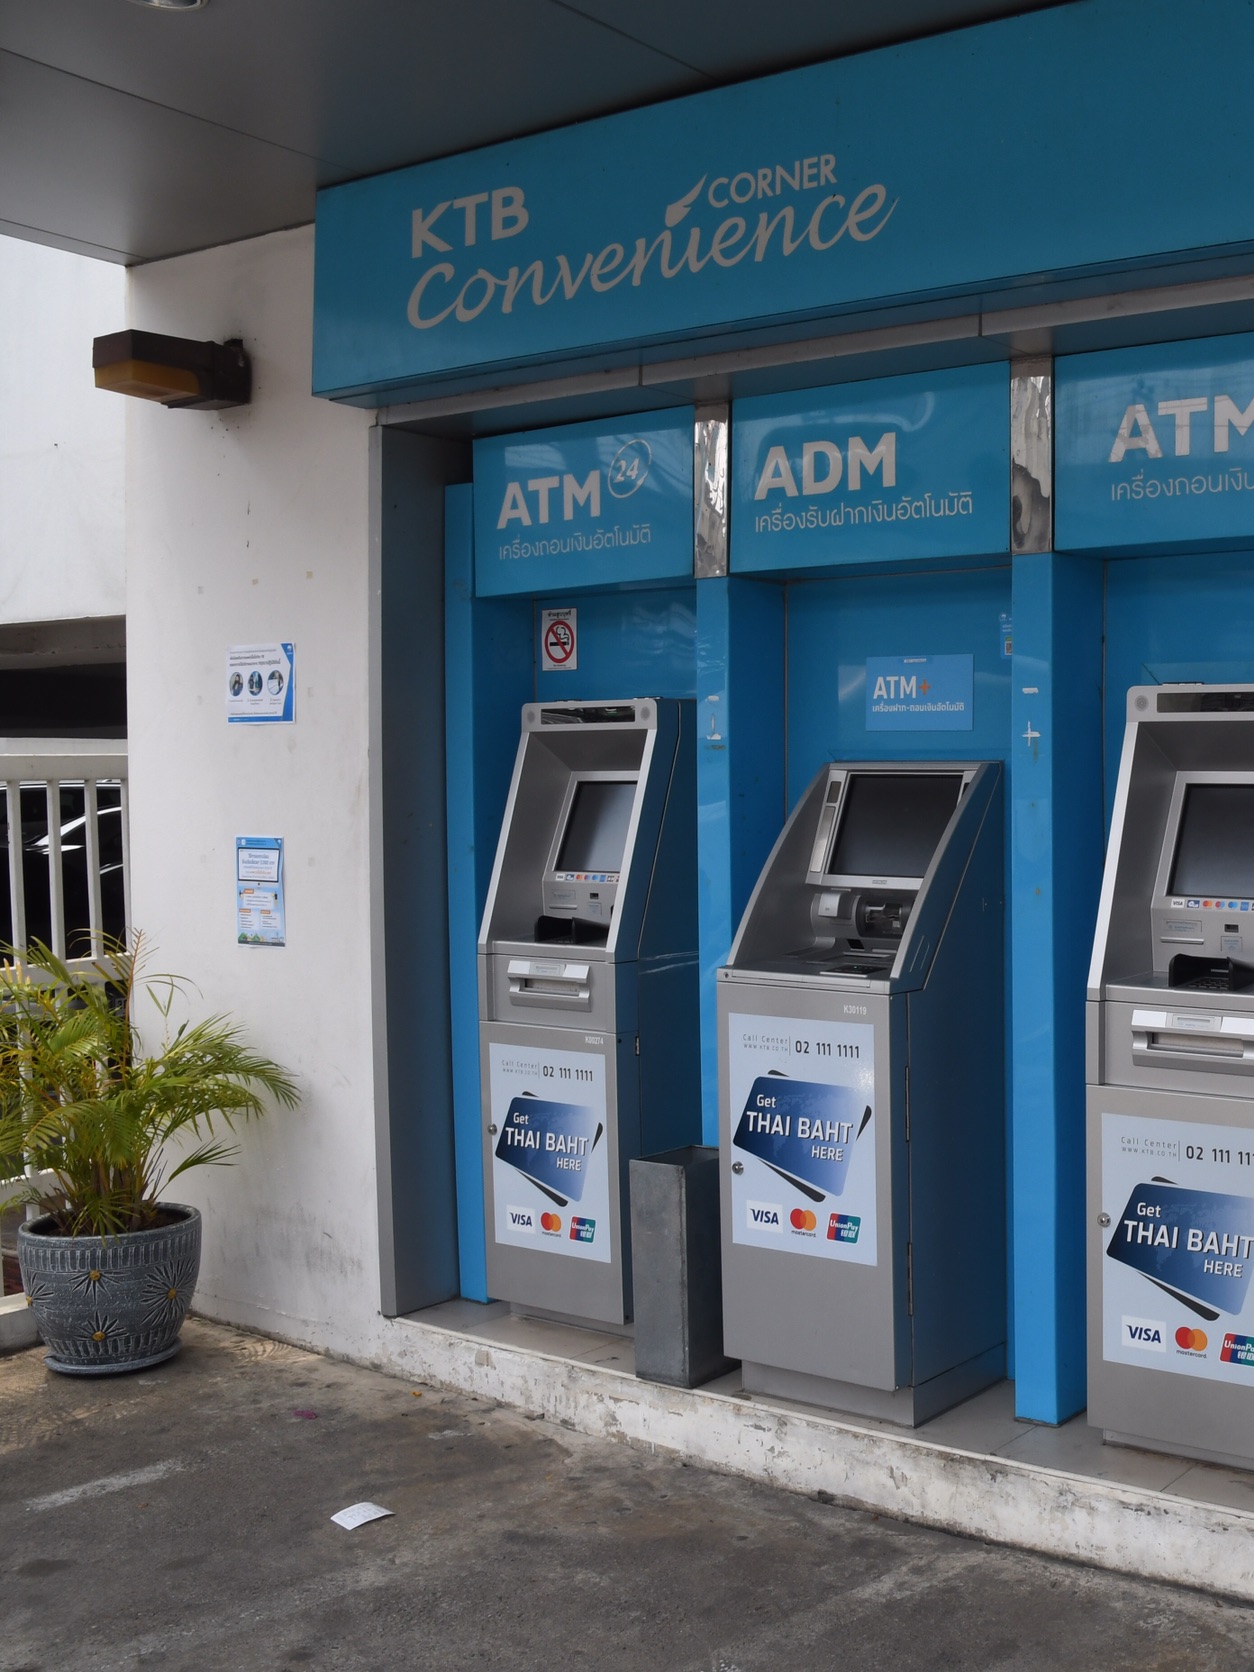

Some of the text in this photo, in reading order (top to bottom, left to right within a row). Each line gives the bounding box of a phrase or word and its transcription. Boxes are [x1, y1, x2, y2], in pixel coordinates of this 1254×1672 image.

[708, 154, 838, 209] CORNER
[411, 186, 530, 259] KTB
[406, 183, 898, 330] Convenience
[754, 432, 897, 501] ADM
[496, 458, 640, 530] ATM 24
[755, 491, 973, 533] เครื่องรับฝากเงินอัตโนมัติ
[499, 523, 651, 561] เครื่องถอนเงินอัตโนมัติ
[843, 1004, 867, 1015] K30119
[743, 1034, 860, 1058] Call Center 02 111 1111
[517, 1061, 537, 1069] Center
[543, 1065, 554, 1077] 02
[559, 1067, 571, 1079] 111
[576, 1069, 593, 1081] 1111
[756, 1094, 776, 1108] Get
[513, 1112, 529, 1124] Get
[746, 1111, 853, 1144] THAI BAHT
[505, 1127, 589, 1156] THAI BAHT
[1121, 1136, 1139, 1145] Call
[1144, 1138, 1177, 1149] Center
[1186, 1145, 1203, 1161] 02
[1212, 1148, 1230, 1164] 111
[811, 1145, 844, 1161] HERE
[556, 1157, 581, 1171] HERE
[510, 1212, 532, 1226] VISA
[750, 1208, 779, 1225] VISA
[1137, 1202, 1161, 1218] Get
[571, 1221, 594, 1234] UnionPay
[791, 1229, 816, 1238] mastercard
[830, 1219, 859, 1235] UnionPay
[1124, 1219, 1179, 1249] THAI
[1203, 1259, 1243, 1278] HERE
[1126, 1324, 1161, 1344] VISA
[1176, 1349, 1207, 1359] mastercard
